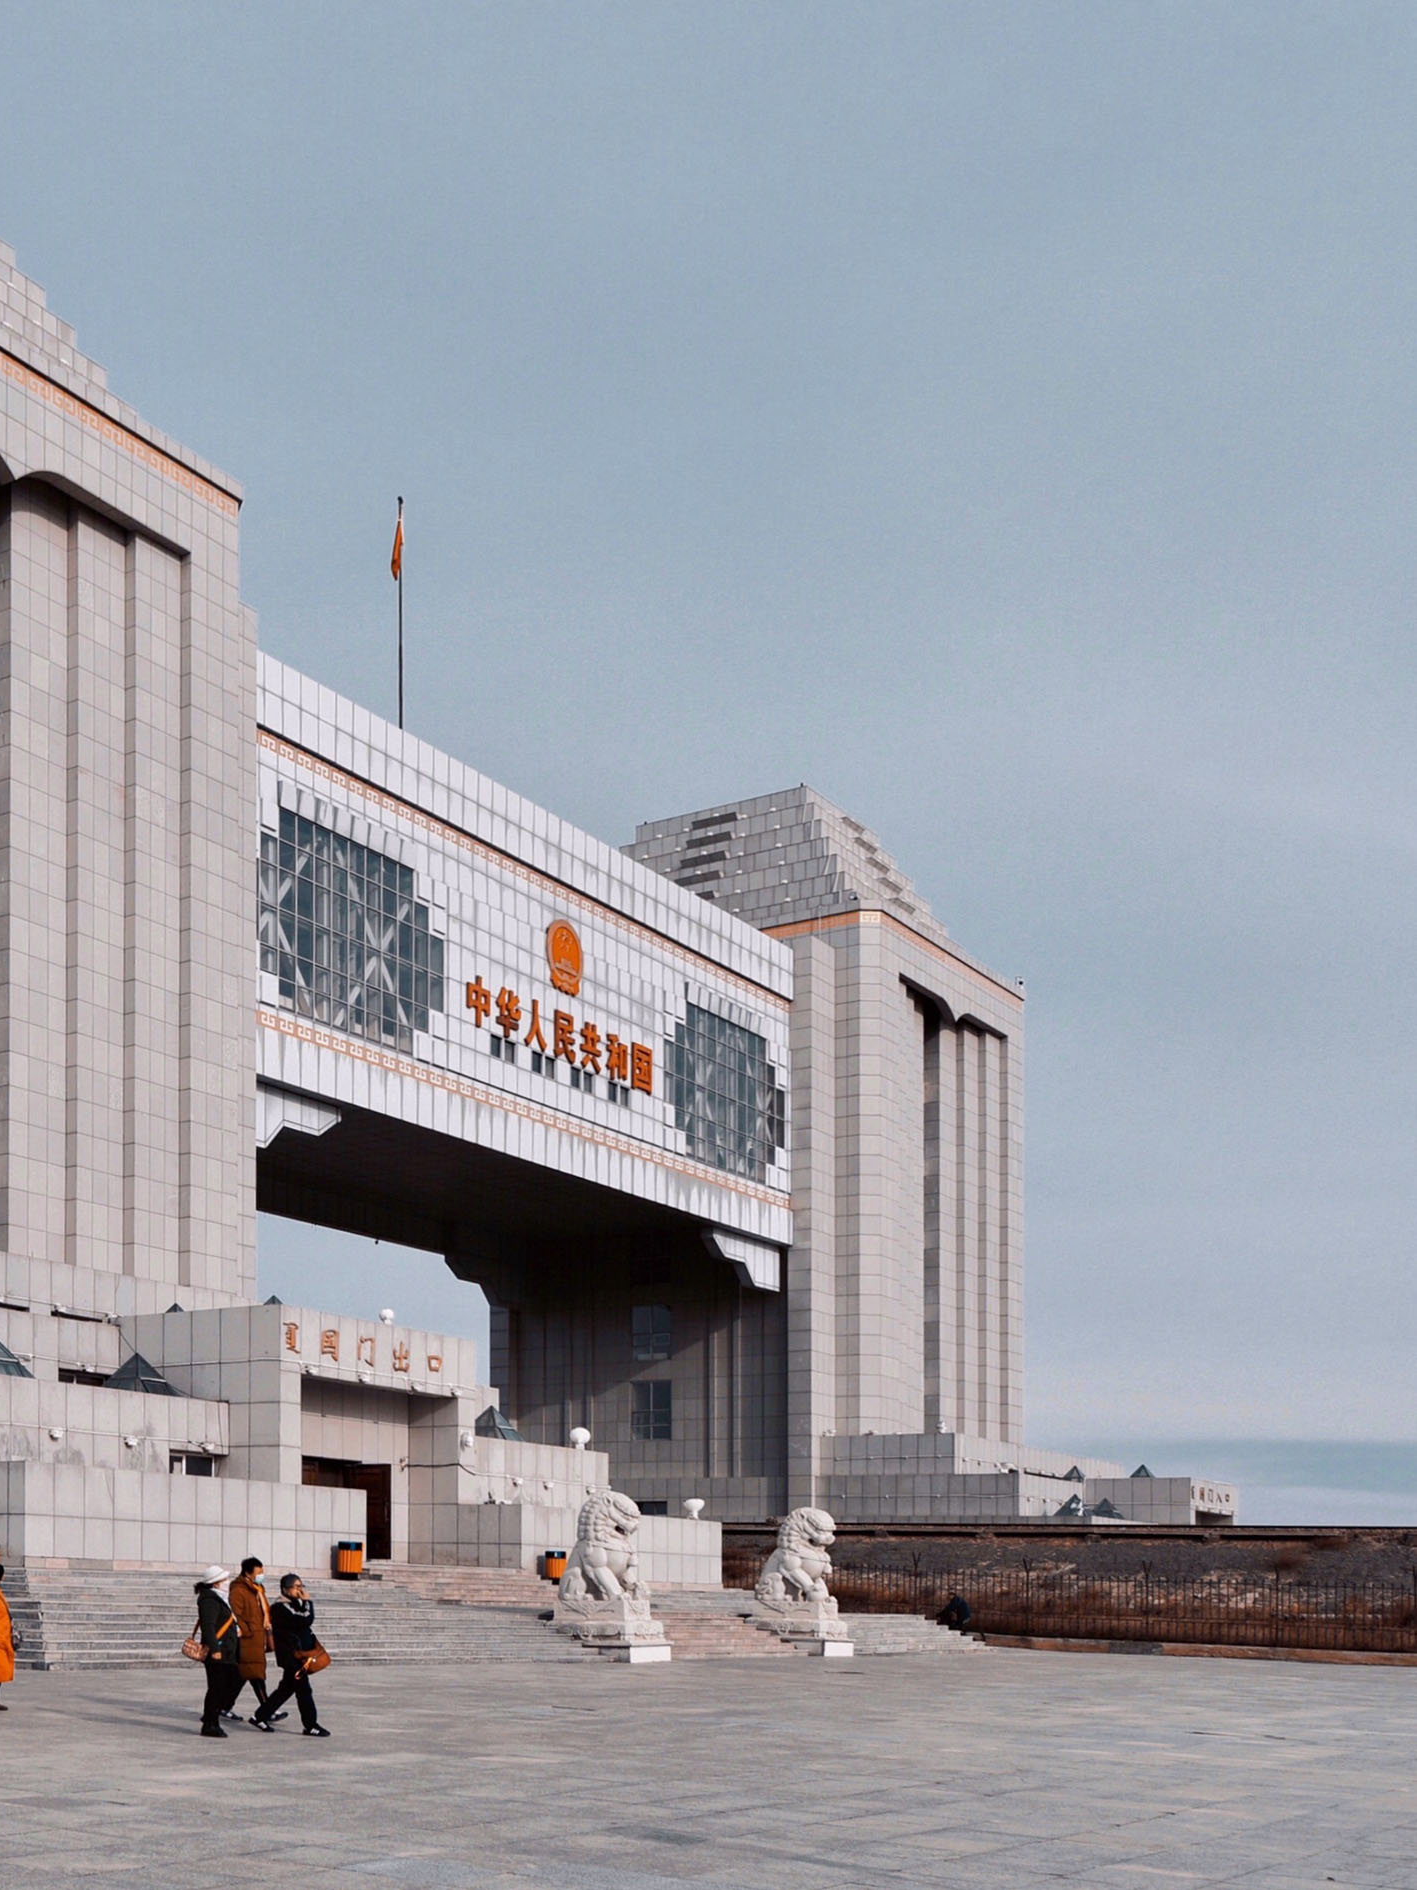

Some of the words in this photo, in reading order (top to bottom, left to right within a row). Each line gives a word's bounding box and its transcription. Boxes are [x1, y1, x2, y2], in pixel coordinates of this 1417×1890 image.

[465, 974, 654, 1095] 中华人民共和国
